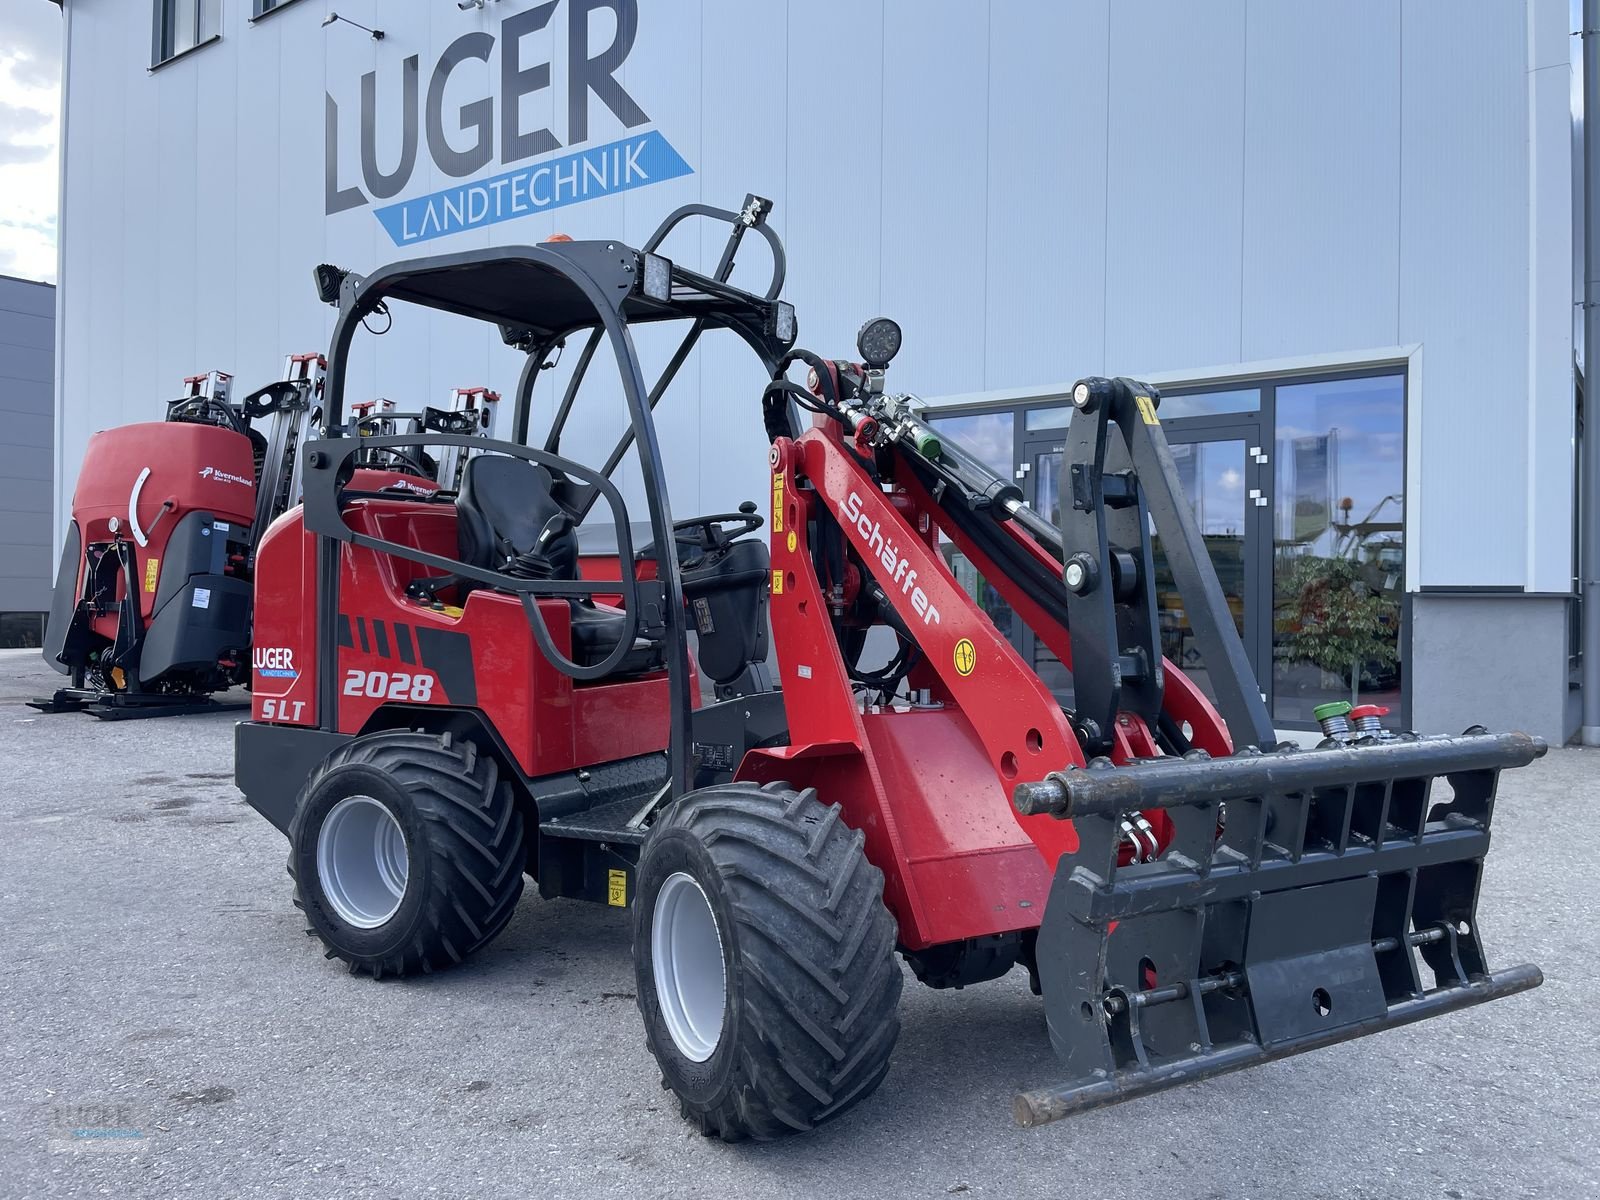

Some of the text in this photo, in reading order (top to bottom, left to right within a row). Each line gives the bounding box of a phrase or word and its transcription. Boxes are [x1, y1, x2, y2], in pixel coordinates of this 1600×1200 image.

[325, 0, 652, 216] LUGER
[403, 139, 649, 241] LANDTECHNIK
[214, 469, 253, 487] Kverneland
[840, 491, 940, 625] Schäffer
[252, 648, 294, 670] LUGER
[343, 669, 435, 702] 2028
[261, 699, 306, 722] SLT
